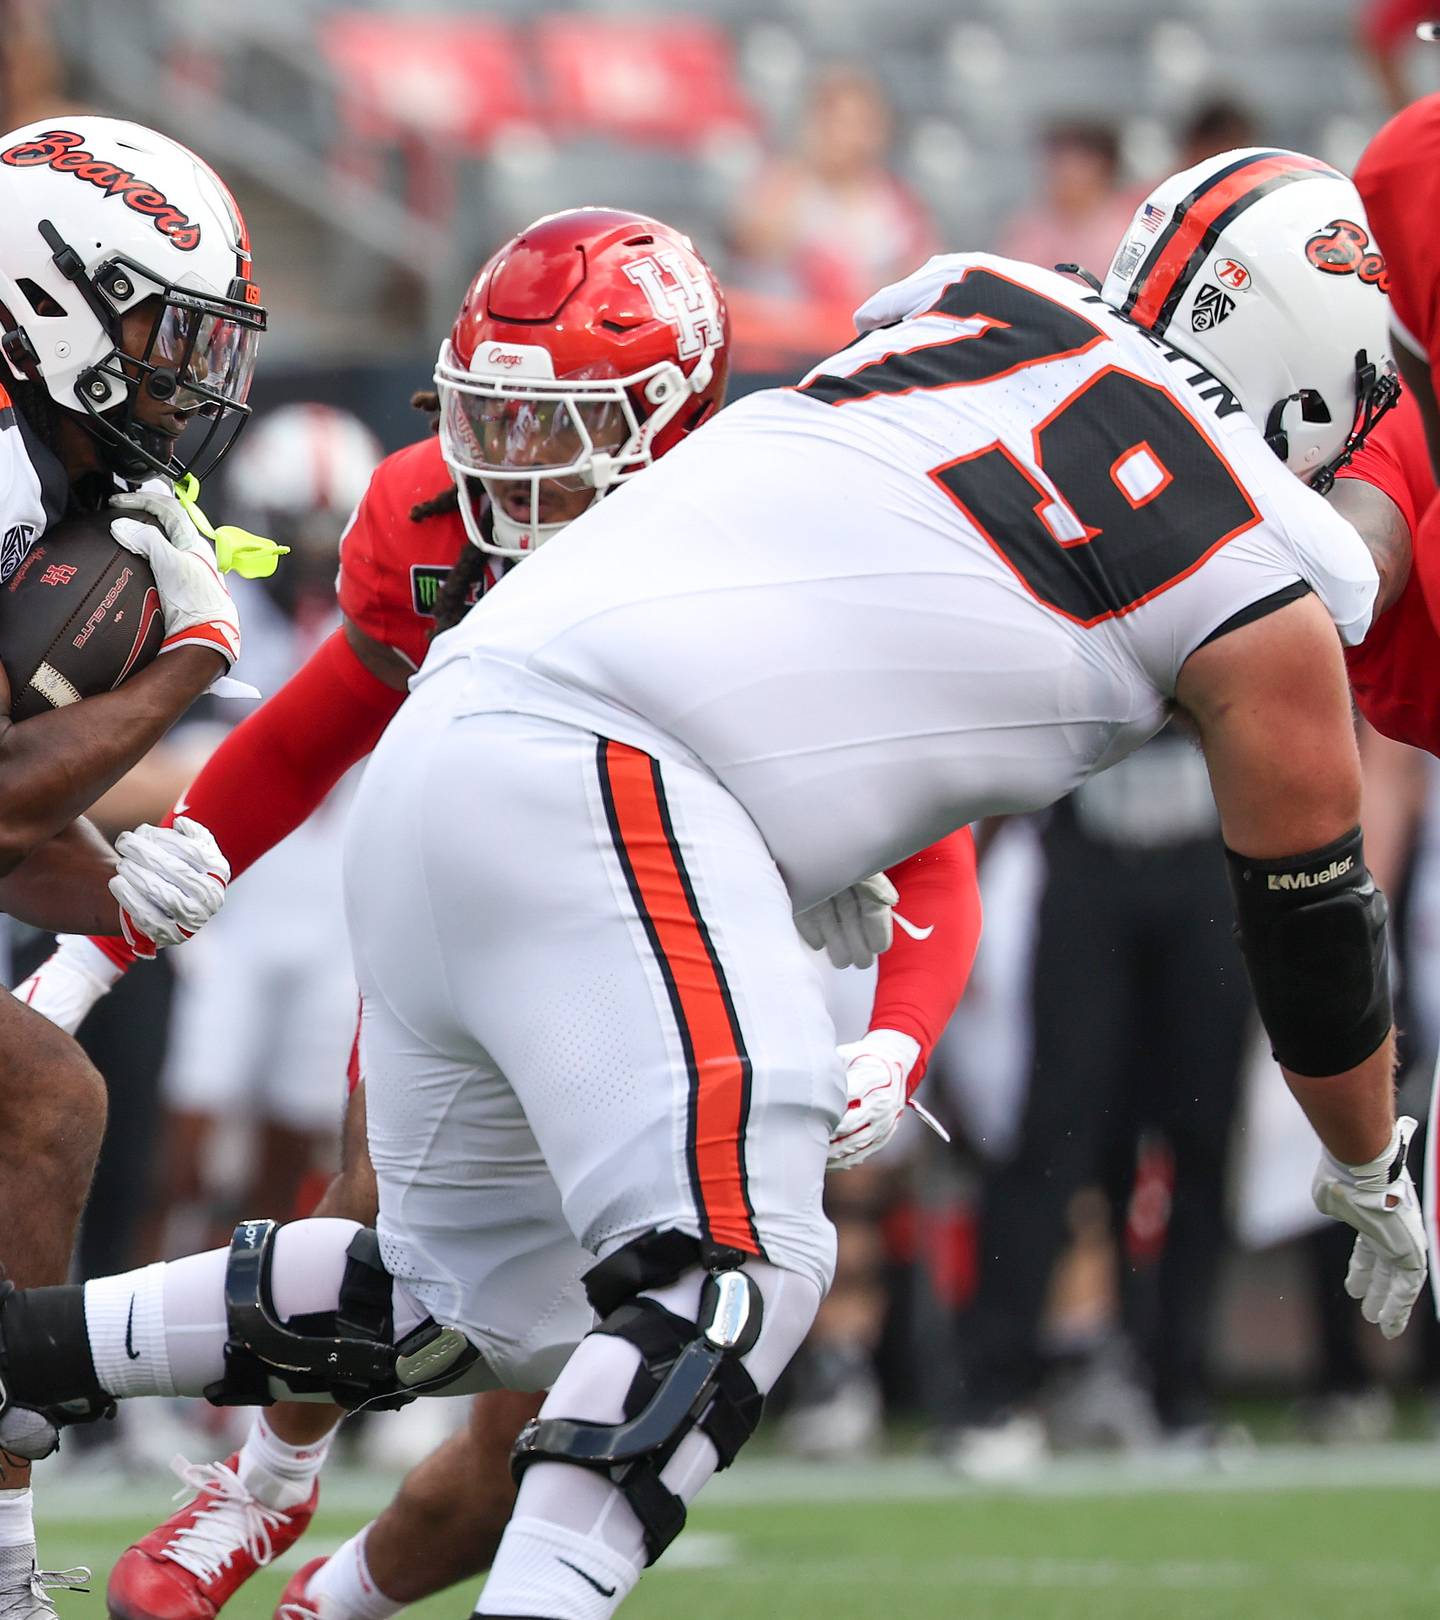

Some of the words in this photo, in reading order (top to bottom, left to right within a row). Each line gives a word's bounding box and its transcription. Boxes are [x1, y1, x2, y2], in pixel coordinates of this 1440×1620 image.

[0, 130, 201, 251] Beavers
[1219, 260, 1247, 287] 79
[782, 265, 1264, 628] 79
[101, 567, 134, 609] VAPOR
[72, 607, 107, 649] ELITE
